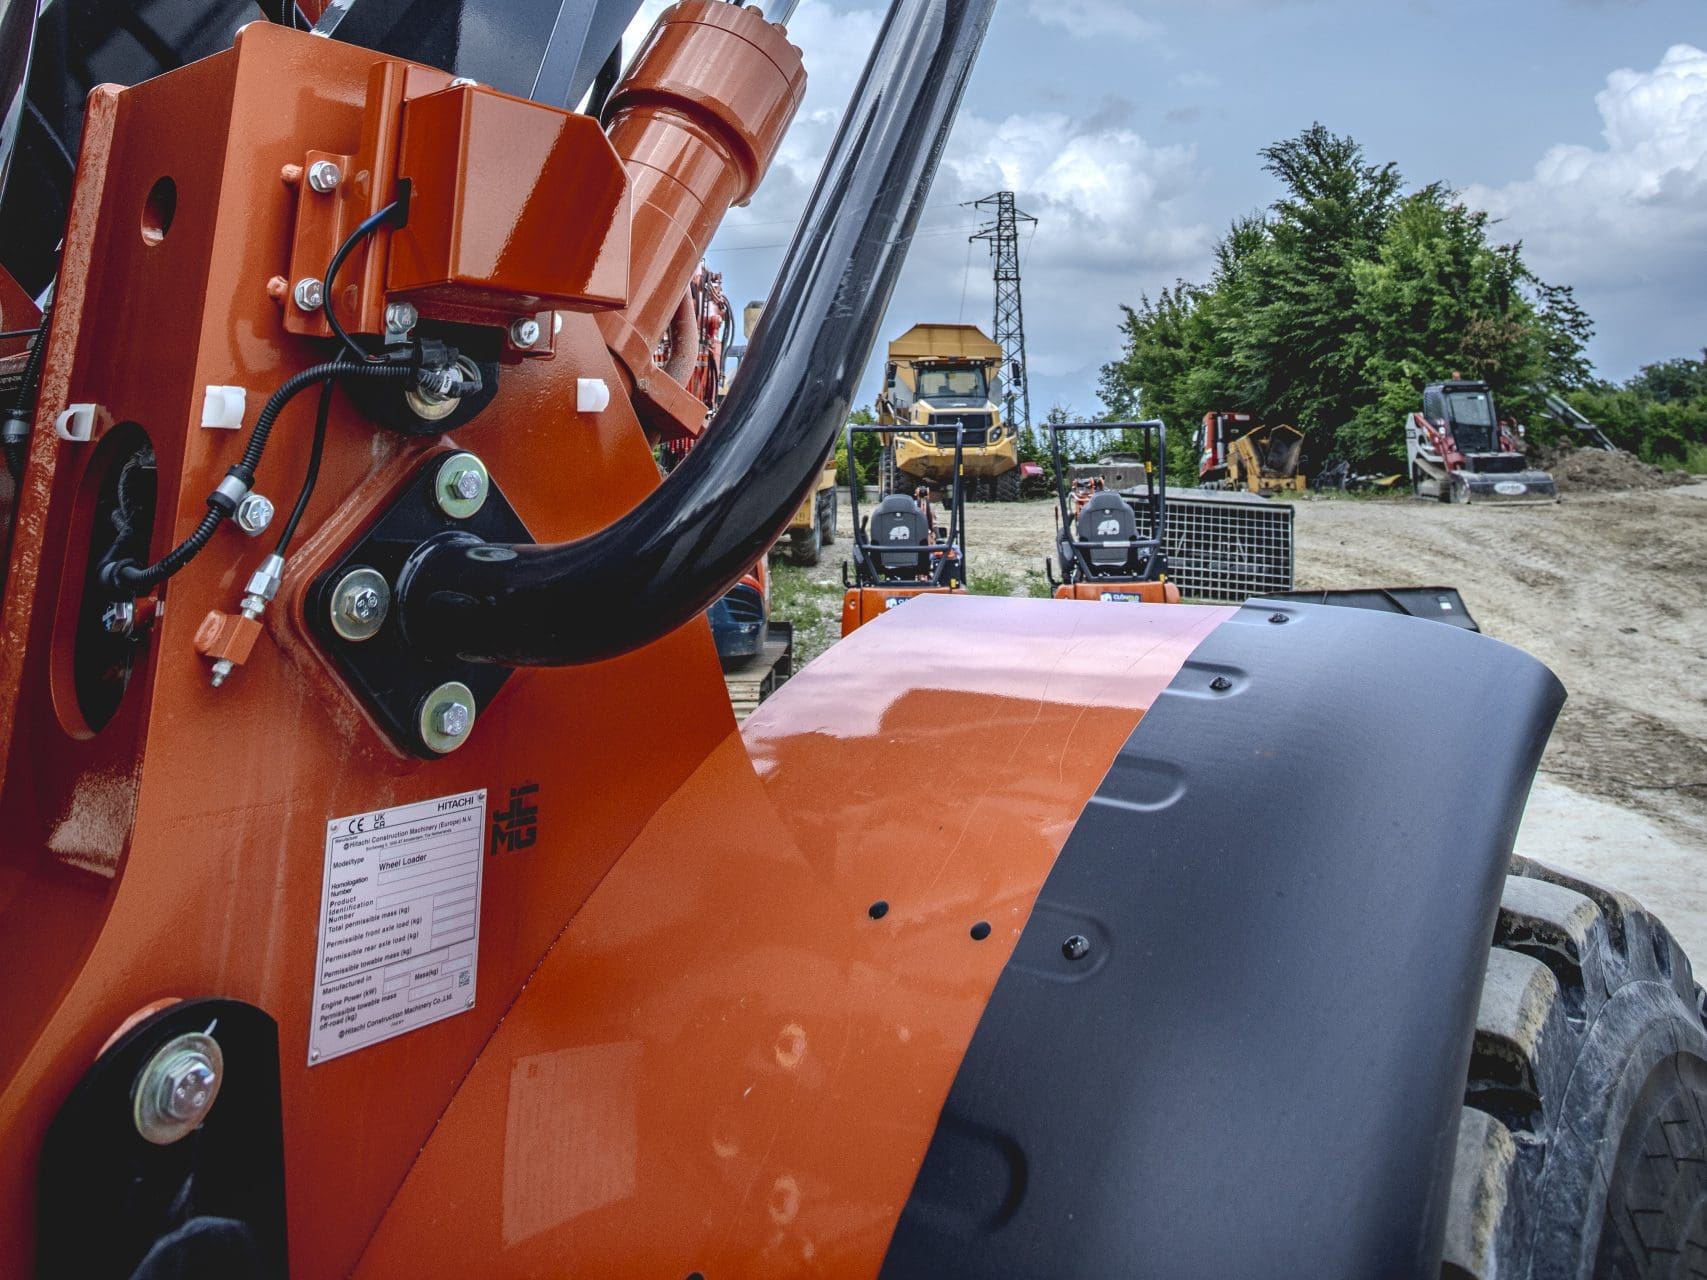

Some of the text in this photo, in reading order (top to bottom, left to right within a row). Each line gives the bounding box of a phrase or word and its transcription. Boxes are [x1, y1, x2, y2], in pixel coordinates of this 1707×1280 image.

[437, 796, 473, 811] HITACHI
[349, 837, 370, 848] Hitachi
[371, 828, 408, 843] Construction
[409, 822, 437, 835] Machinery
[438, 817, 461, 828] (Europe)
[462, 815, 471, 823] N.V.
[378, 852, 427, 871] Wheel Loader
[330, 887, 351, 898] Number
[331, 875, 368, 891] Homologation
[328, 898, 373, 916] Identification
[329, 895, 356, 908] Product
[328, 911, 354, 924] Number
[328, 905, 410, 934] Total permissible mass (kg)
[326, 916, 422, 949] Permissible front axle load (kg)
[324, 930, 418, 964] Permissible rear axle load (kg)
[323, 947, 411, 979] Permissible towable mass (kg)
[322, 974, 371, 995] Manufactured in
[319, 1005, 355, 1022] Permissible
[381, 992, 396, 1002] mass
[320, 987, 376, 1011] Engine Power (kW)
[319, 1012, 357, 1031] off-road (kg)
[344, 1022, 365, 1035] Hitachi
[366, 1009, 402, 1028] Construction
[403, 1000, 431, 1015] Machinery
